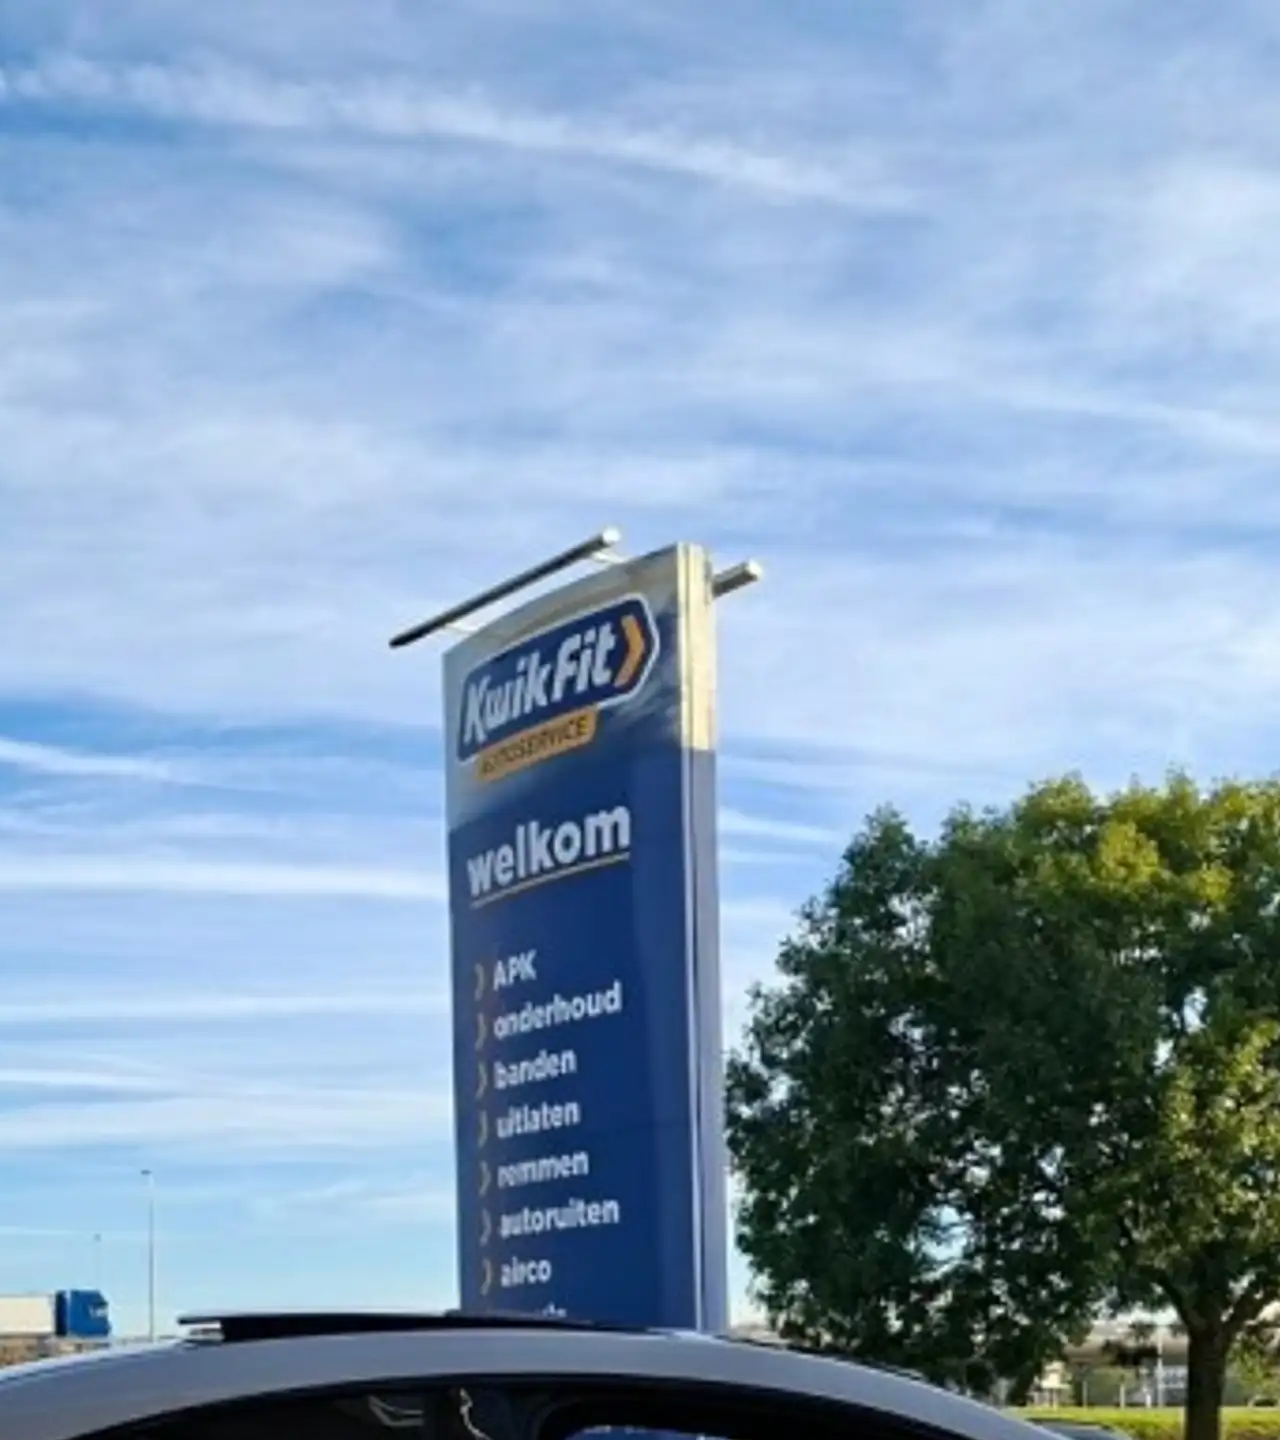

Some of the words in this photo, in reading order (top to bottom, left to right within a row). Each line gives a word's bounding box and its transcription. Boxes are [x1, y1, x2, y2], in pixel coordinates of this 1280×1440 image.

[467, 805, 631, 897] welkom
[492, 949, 538, 991] APK
[493, 980, 622, 1039] onderhoud
[494, 1048, 577, 1090] banden
[496, 1100, 581, 1139] uitlaten
[496, 1150, 590, 1189] remmen
[500, 1197, 620, 1239] autoruiten
[500, 1256, 552, 1288] airco
